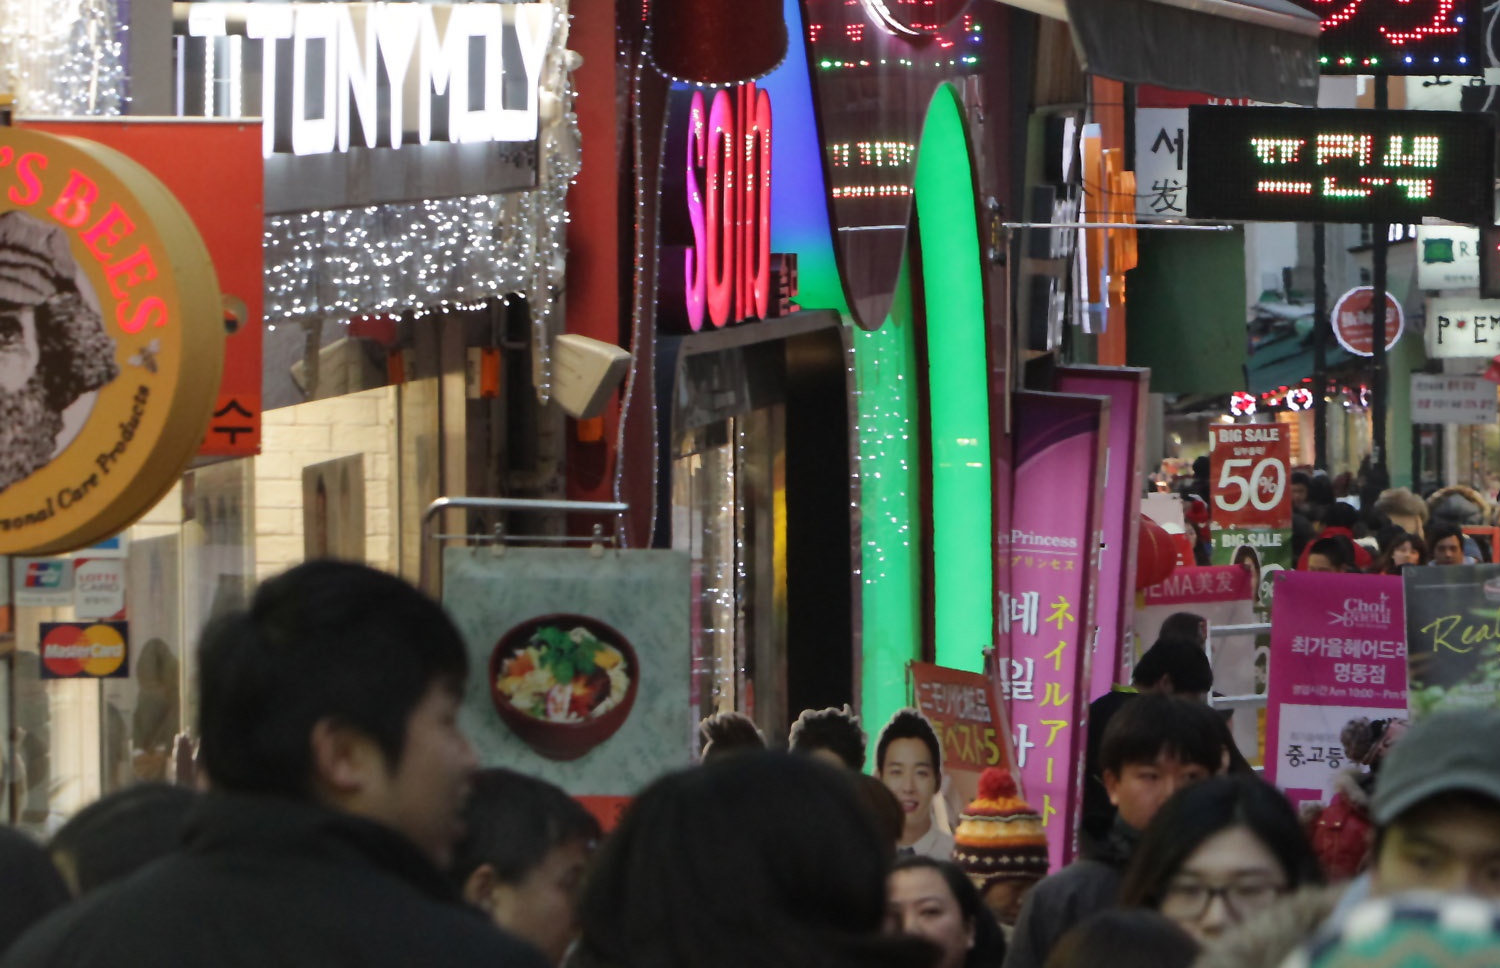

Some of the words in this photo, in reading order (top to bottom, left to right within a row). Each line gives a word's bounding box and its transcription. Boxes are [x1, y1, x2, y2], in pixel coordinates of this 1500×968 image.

[46, 167, 170, 335] BEES
[1218, 428, 1243, 443] BIG
[1244, 428, 1280, 442] SALE
[56, 474, 101, 511] Care
[96, 383, 151, 476] Products
[1010, 528, 1079, 549] Princess
[1221, 533, 1245, 548] BIG
[1247, 532, 1283, 547] SALE
[44, 642, 123, 660] MasterCard
[1333, 662, 1387, 685] 명동점
[1039, 594, 1075, 829] ネイルアート
